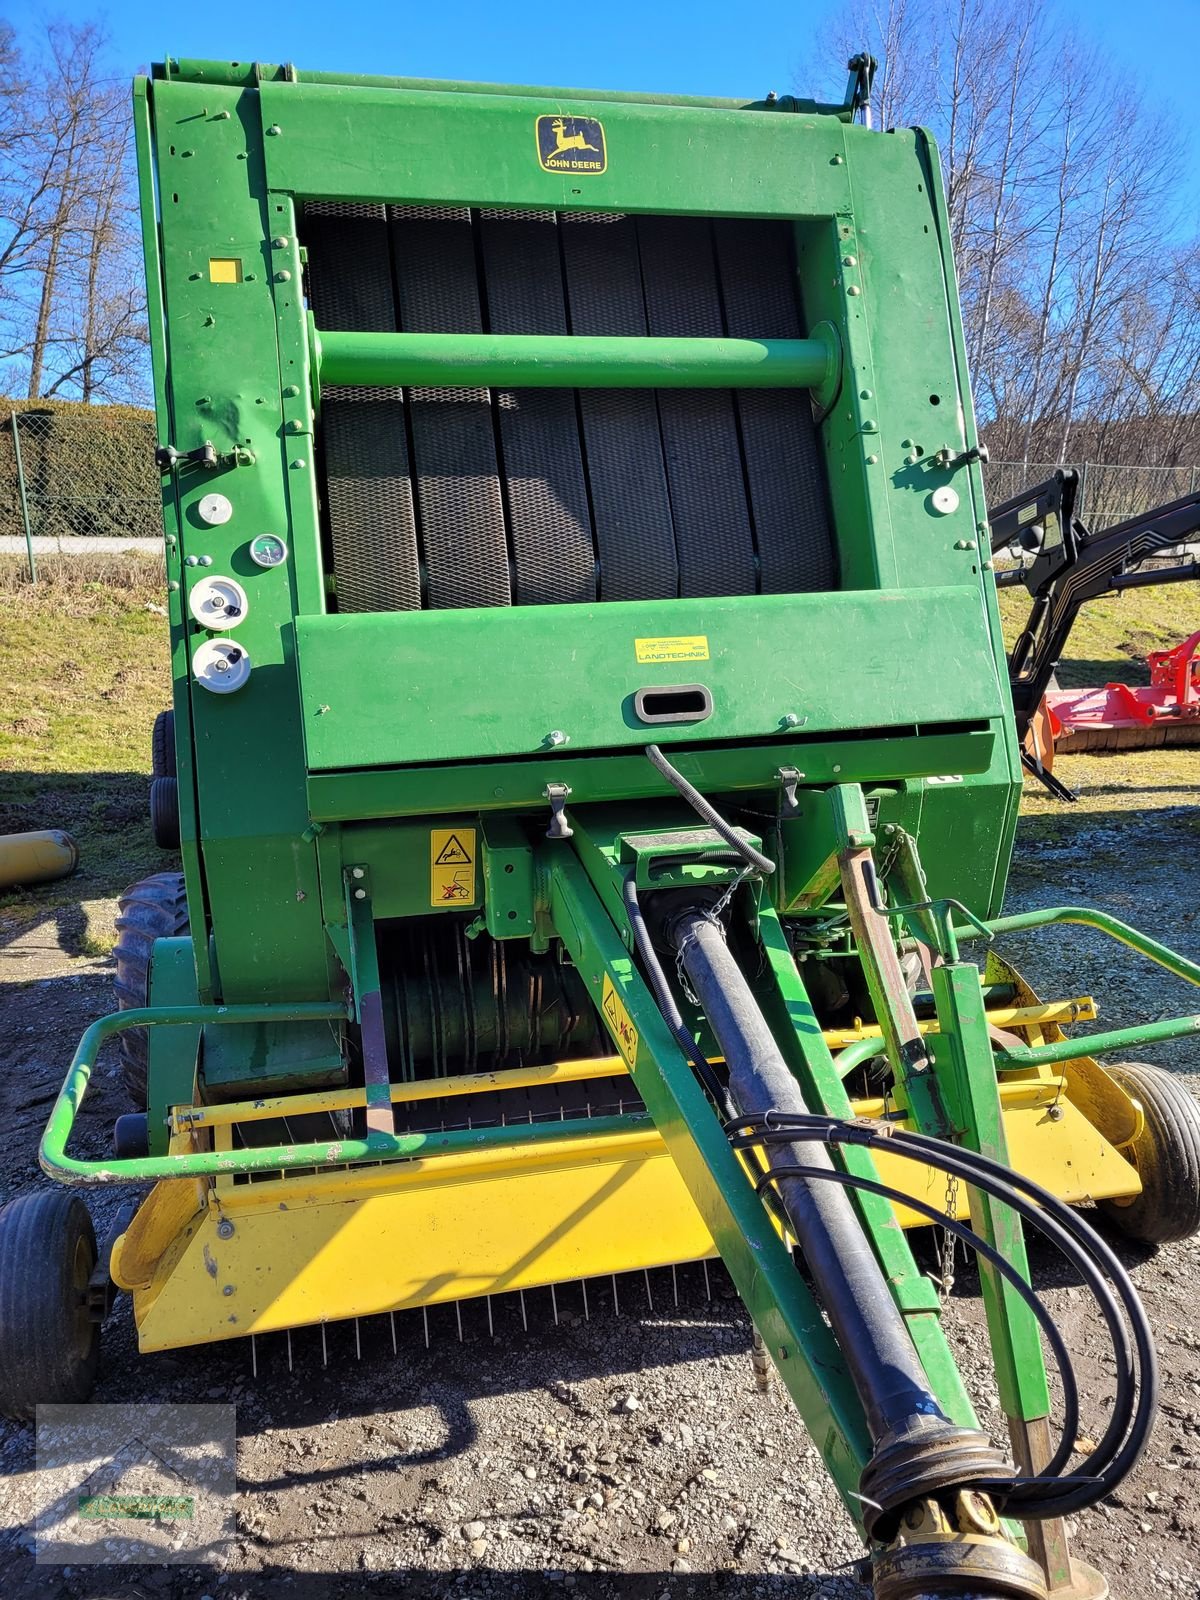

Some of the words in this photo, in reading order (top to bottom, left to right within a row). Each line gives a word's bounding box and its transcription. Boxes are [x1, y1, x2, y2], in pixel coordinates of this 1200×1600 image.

[544, 159, 570, 168] JOHN
[571, 161, 602, 169] DEERE
[638, 651, 706, 660] LANDTECHNIK
